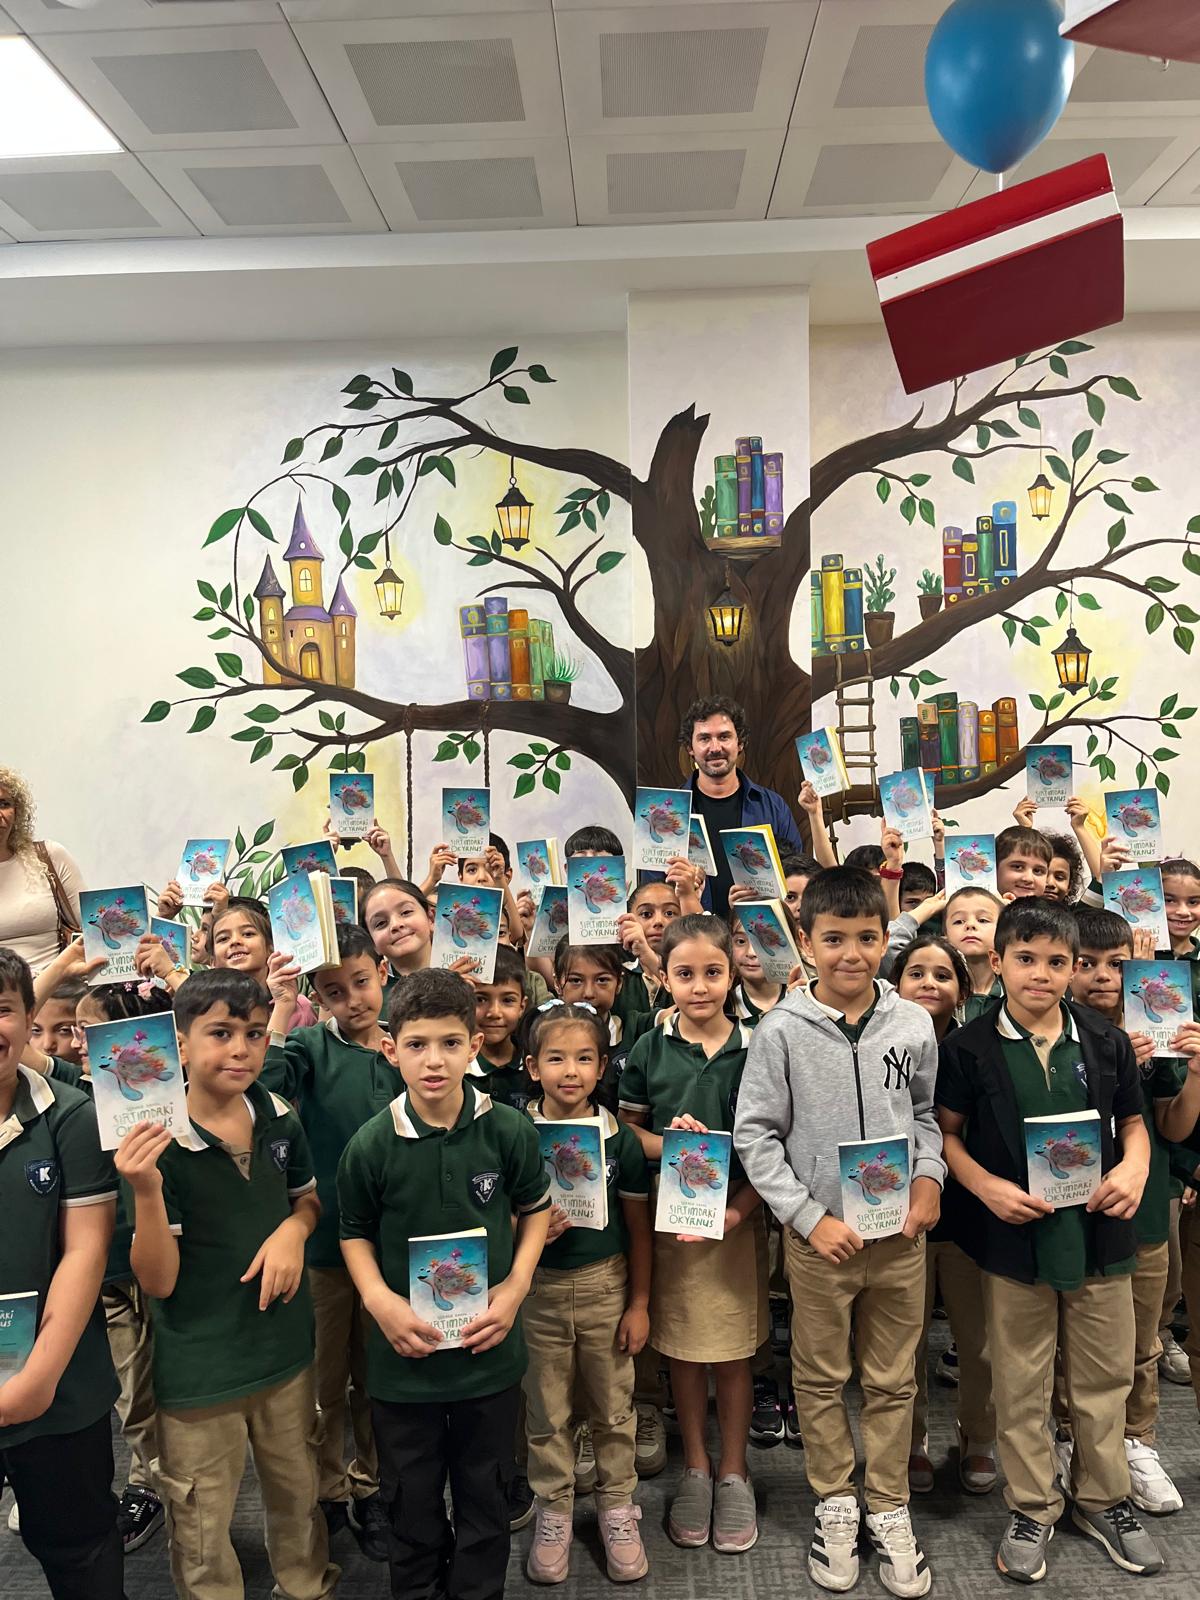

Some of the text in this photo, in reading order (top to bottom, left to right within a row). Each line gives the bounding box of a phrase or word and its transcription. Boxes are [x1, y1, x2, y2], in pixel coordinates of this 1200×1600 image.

[882, 1045, 912, 1090] NY
[1043, 1179, 1092, 1195] SIRTIMDAKİ
[1044, 1188, 1090, 1203] OKYANUS
[669, 1204, 717, 1219] SIRTIMDAKİ
[857, 1205, 903, 1223] SIRTIMDAKİ
[669, 1214, 714, 1228] OKYANUS
[858, 1216, 902, 1232] OKYANUS
